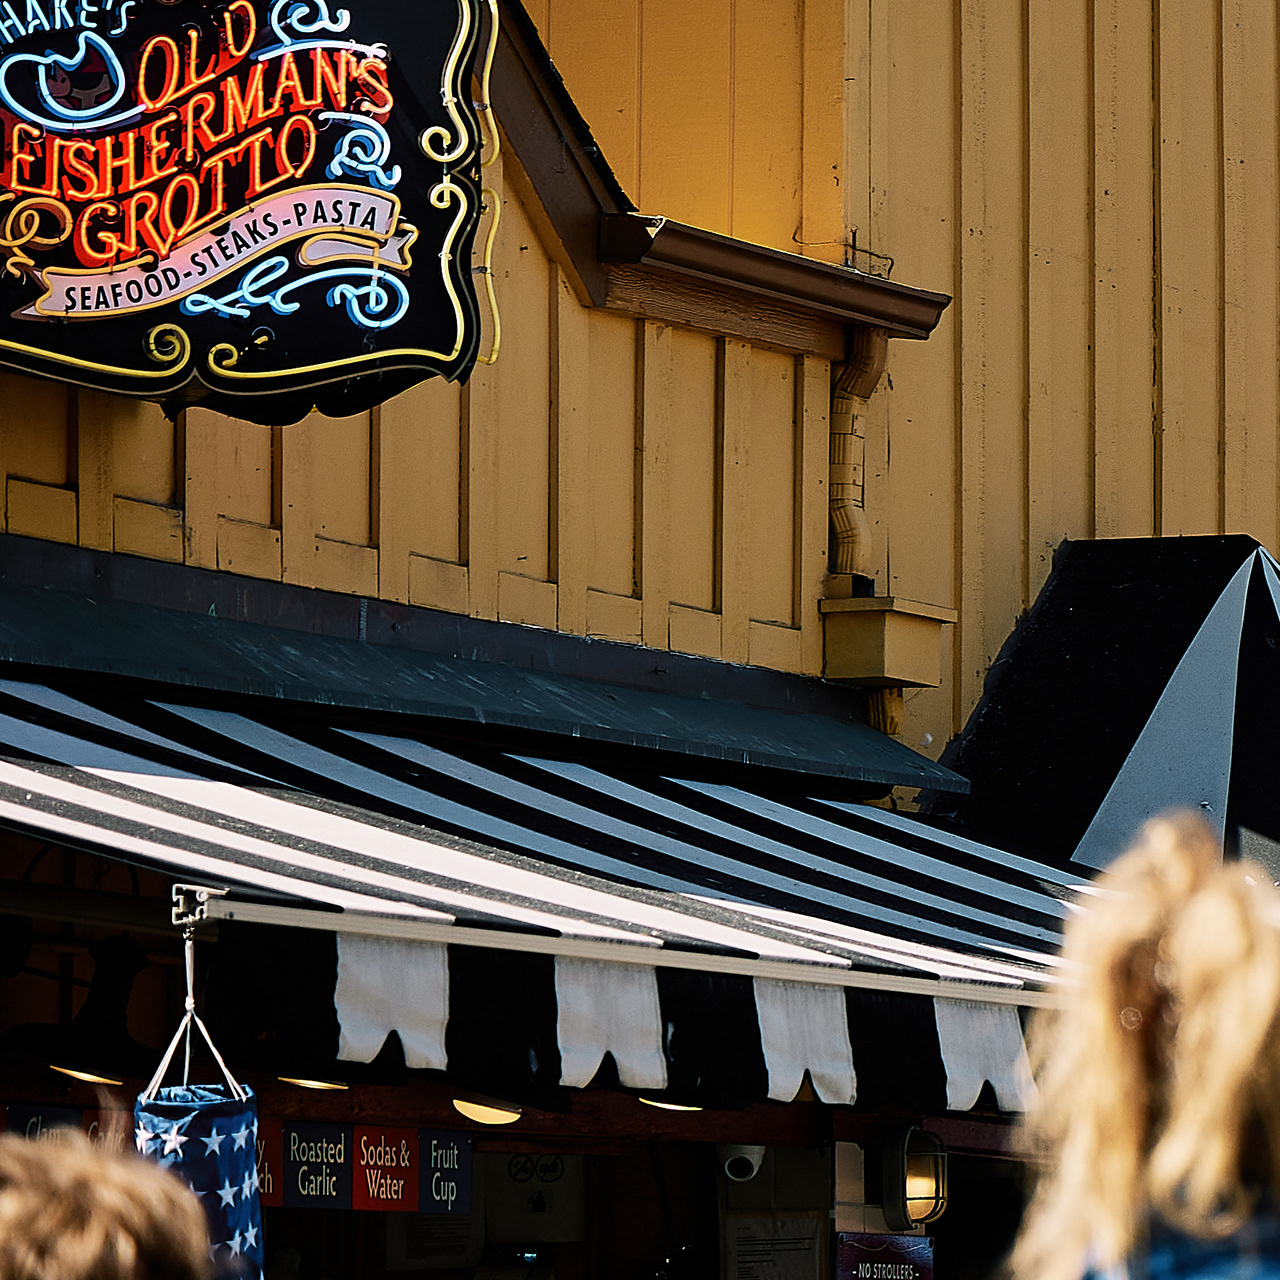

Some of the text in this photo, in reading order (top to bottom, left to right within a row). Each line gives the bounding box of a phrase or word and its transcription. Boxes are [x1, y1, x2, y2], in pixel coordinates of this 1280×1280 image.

[138, 0, 256, 111] OLD
[0, 45, 395, 202] FISHERMAN'S
[73, 114, 317, 269] GROTTO
[290, 1132, 345, 1164] Roasted
[359, 1135, 410, 1168] Sodas &
[431, 1139, 459, 1170] Fruit
[297, 1165, 338, 1197] Garlic
[365, 1168, 405, 1200] Water
[431, 1171, 457, 1211] Cup
[873, 1263, 914, 1279] STROLLERS
